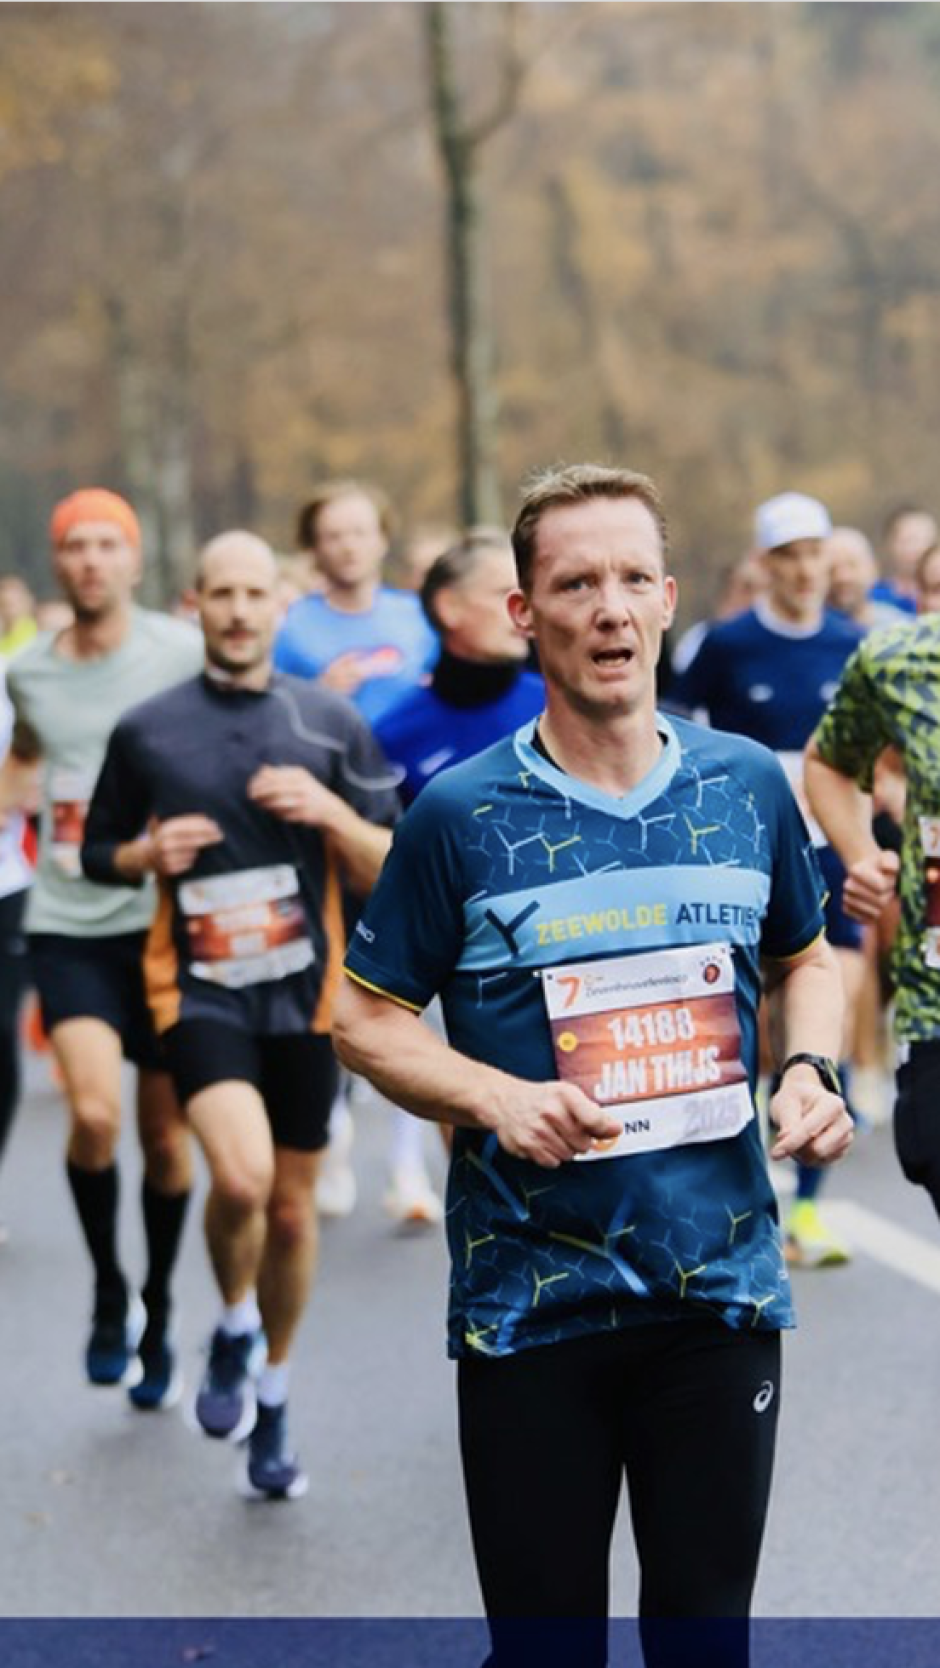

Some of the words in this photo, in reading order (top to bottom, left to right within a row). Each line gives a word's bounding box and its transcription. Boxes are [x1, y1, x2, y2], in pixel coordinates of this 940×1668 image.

[537, 904, 667, 945] ZEEWOLDE
[608, 1008, 695, 1050] 14188
[594, 1058, 646, 1100] JAN
[651, 1045, 721, 1092] THIJS
[624, 1119, 650, 1134] NN
